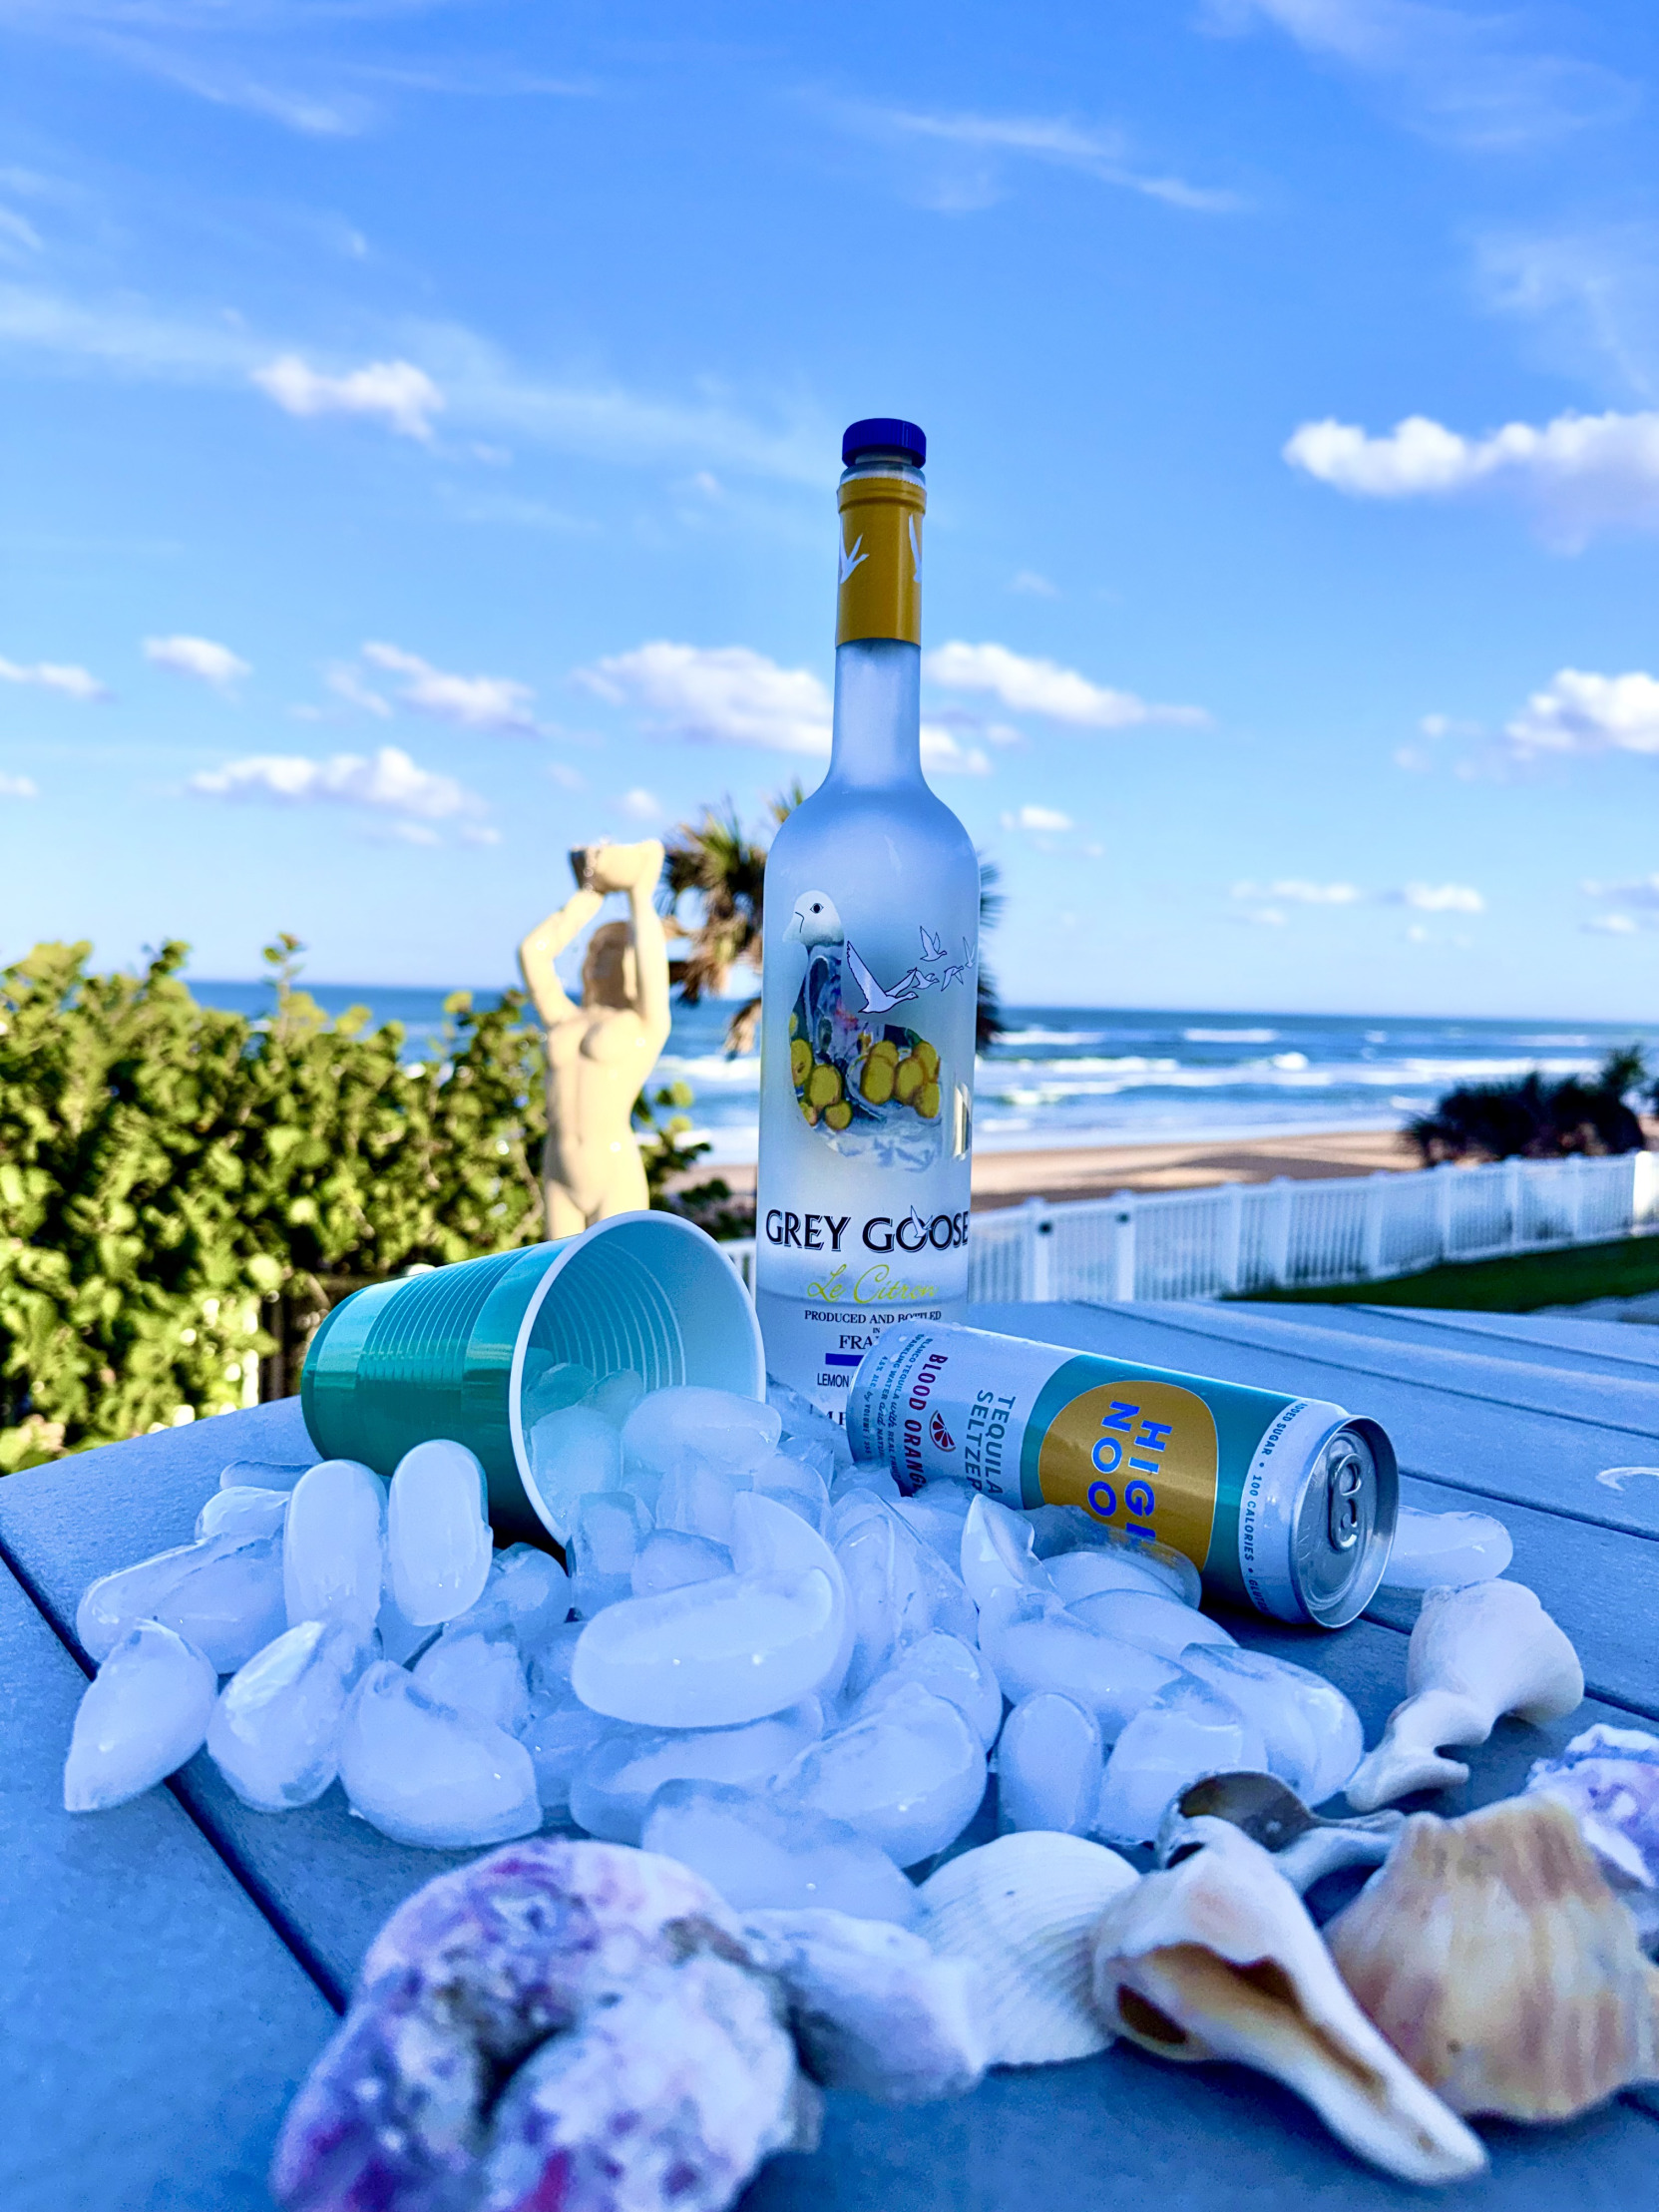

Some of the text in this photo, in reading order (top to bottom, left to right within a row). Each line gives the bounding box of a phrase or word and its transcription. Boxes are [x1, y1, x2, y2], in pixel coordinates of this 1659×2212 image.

[766, 1208, 970, 1254] GREY GOOSE
[807, 1263, 940, 1304] Le Citron
[804, 1309, 867, 1324] PRODUCED
[870, 1313, 895, 1324] AND
[839, 1334, 880, 1349] FRA
[893, 1333, 925, 1369] SPARKLING
[909, 1337, 934, 1363] BLANCO
[817, 1372, 850, 1388] LEMON
[881, 1370, 897, 1401] WATER
[892, 1364, 913, 1400] TEQUILA
[908, 1353, 949, 1411] BLOOD
[984, 1395, 1017, 1495] TEQUILA
[1261, 1422, 1287, 1456] SUGAR
[1249, 1474, 1263, 1497] 100
[1243, 1501, 1257, 1561] CALORIES
